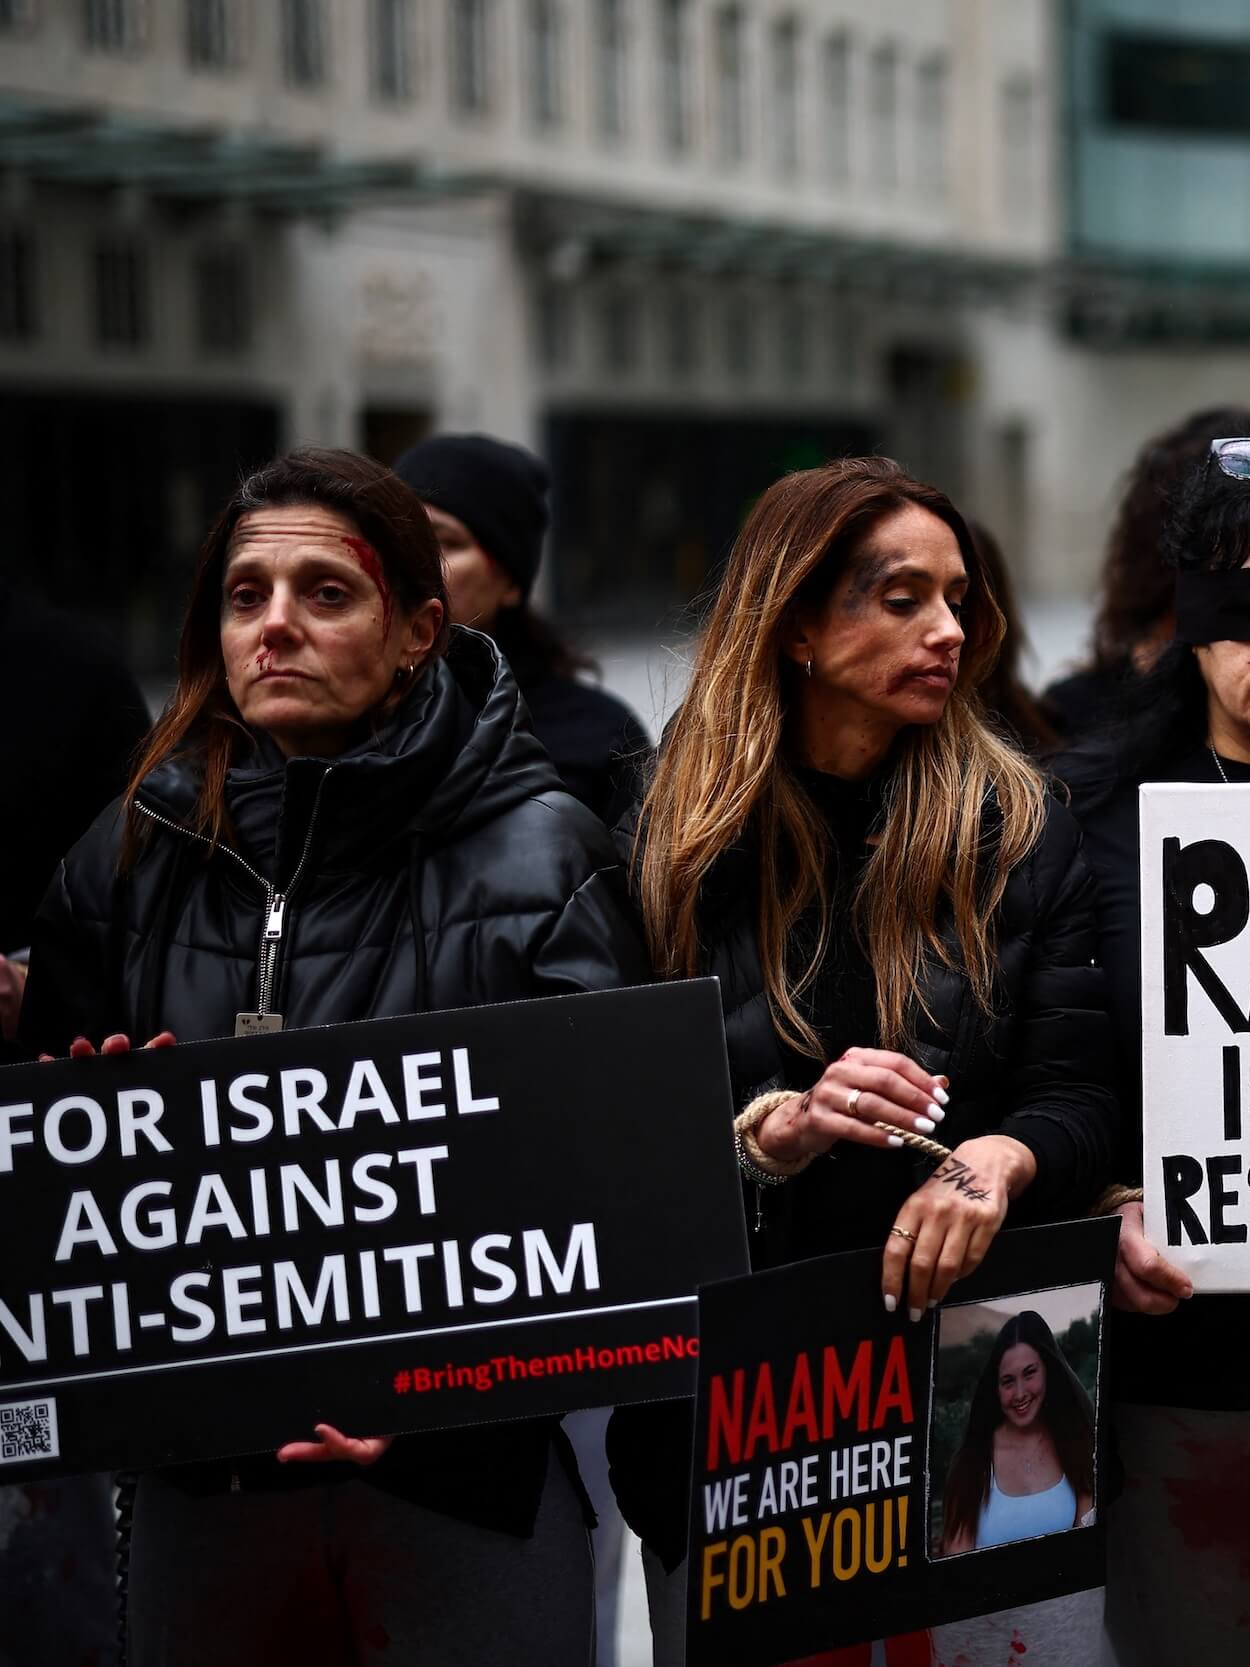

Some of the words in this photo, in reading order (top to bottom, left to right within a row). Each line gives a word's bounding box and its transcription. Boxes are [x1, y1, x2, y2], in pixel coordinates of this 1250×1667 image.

[0, 1088, 174, 1173] FOR
[201, 1048, 499, 1145] ISRAEL
[55, 1145, 449, 1262] AGAINST
[0, 1223, 600, 1361] NTI-SEMITISM
[707, 1336, 914, 1470] NAAMA
[704, 1473, 748, 1533] WE
[758, 1456, 818, 1519] ARE
[831, 1435, 912, 1499] HERE
[701, 1526, 787, 1620] FOR
[803, 1496, 908, 1588] YOU!
